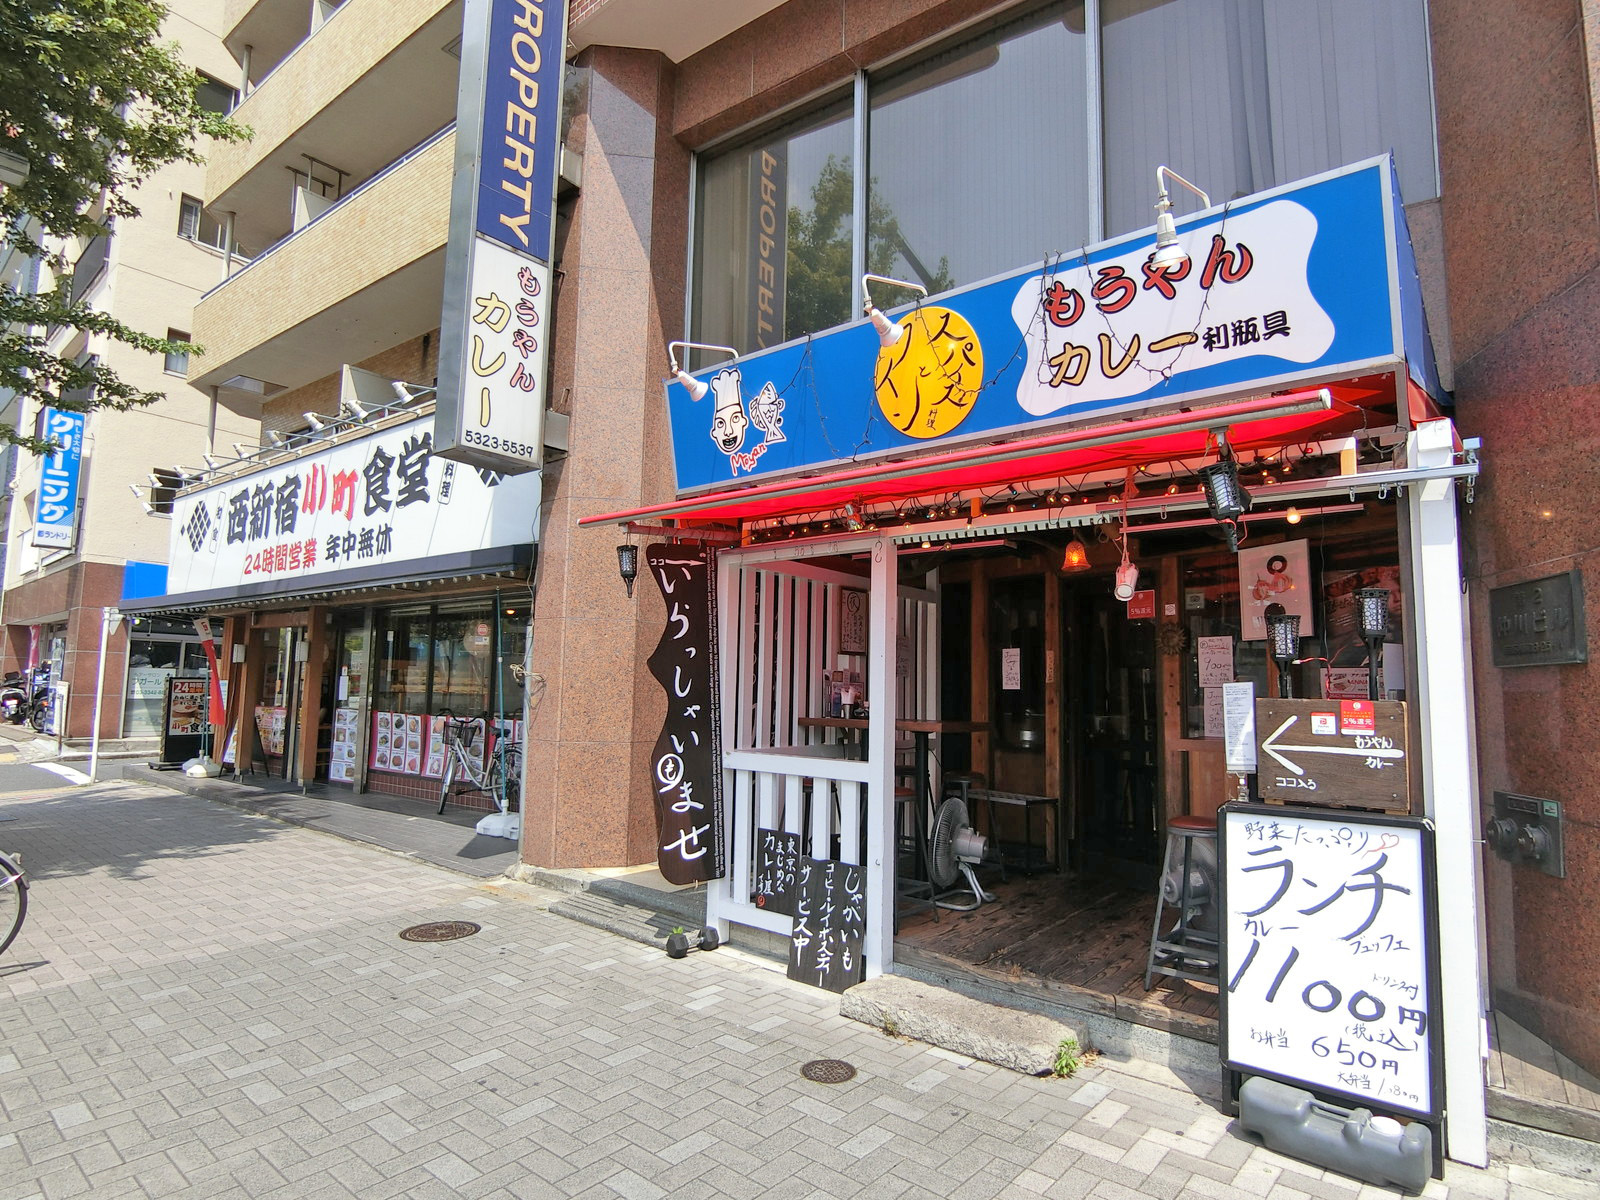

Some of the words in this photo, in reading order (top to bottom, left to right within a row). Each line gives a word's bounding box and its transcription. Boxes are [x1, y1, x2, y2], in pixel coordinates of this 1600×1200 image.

[500, 0, 544, 248] ROPERTY
[1044, 234, 1254, 327] もうやん
[509, 266, 541, 392] もうやん
[472, 291, 512, 427] カレー
[1048, 332, 1198, 388] カレー
[40, 414, 75, 522] クリーニング
[464, 430, 534, 458] 5323-5539
[730, 443, 767, 475] Moyan
[227, 432, 434, 545] 西新宿小町食堂
[244, 537, 318, 575] 24時間営業
[325, 523, 393, 563] 年中無休
[659, 566, 711, 861] いらっしゃいませ
[1343, 717, 1373, 726] 5%還元
[1354, 735, 1393, 749] もうやん
[1364, 756, 1394, 769] カレー
[785, 836, 798, 886] 東京の
[1243, 820, 1369, 855] 野菜たっぷり
[775, 840, 785, 893] まじめな
[1235, 845, 1412, 941] ランチ
[792, 864, 814, 968] サービス中
[840, 867, 863, 971] じゃがいも
[1244, 918, 1300, 937] カレー
[1250, 1027, 1291, 1049] お弁当
[1311, 1036, 1399, 1076] 650円
